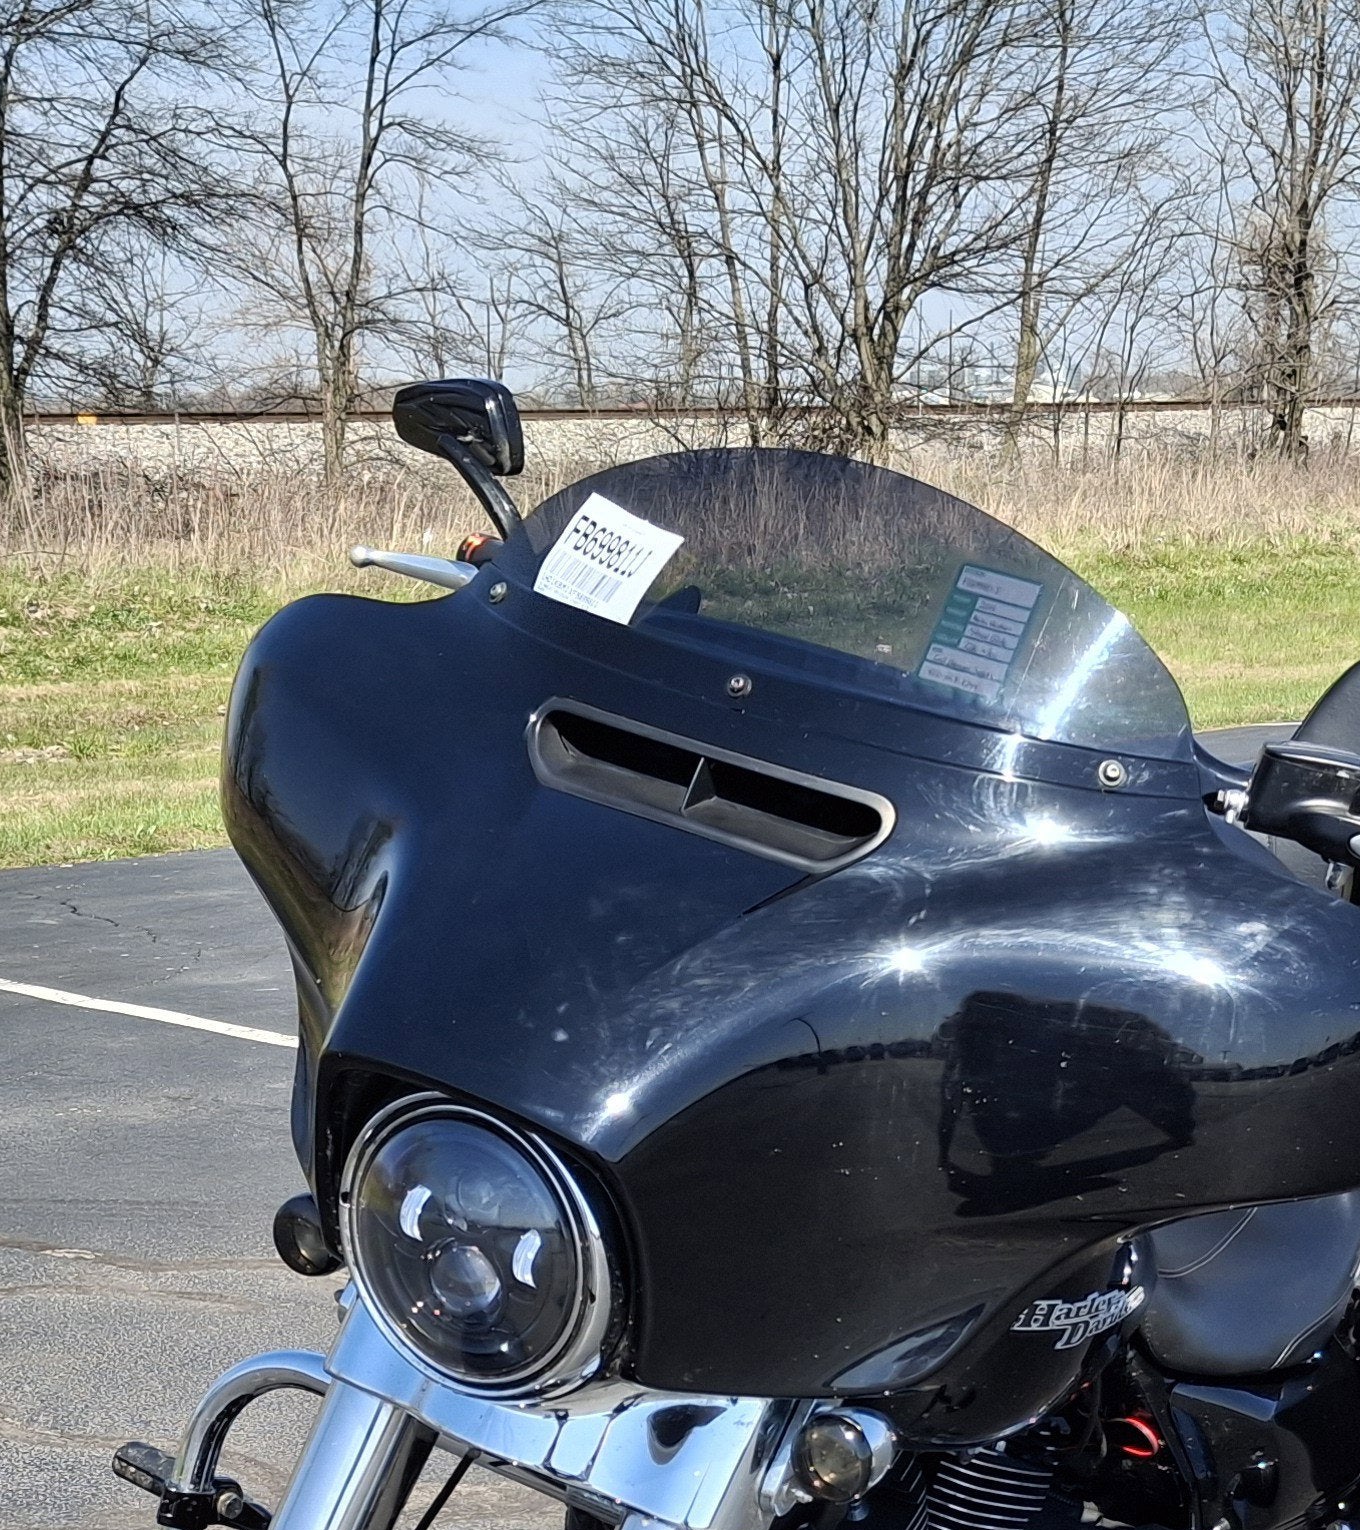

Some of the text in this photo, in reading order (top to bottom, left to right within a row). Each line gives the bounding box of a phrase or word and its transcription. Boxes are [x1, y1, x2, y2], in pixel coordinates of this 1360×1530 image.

[563, 514, 653, 578] FB699811J
[1010, 1289, 1127, 1331] Harley
[1054, 1286, 1145, 1350] Davids
